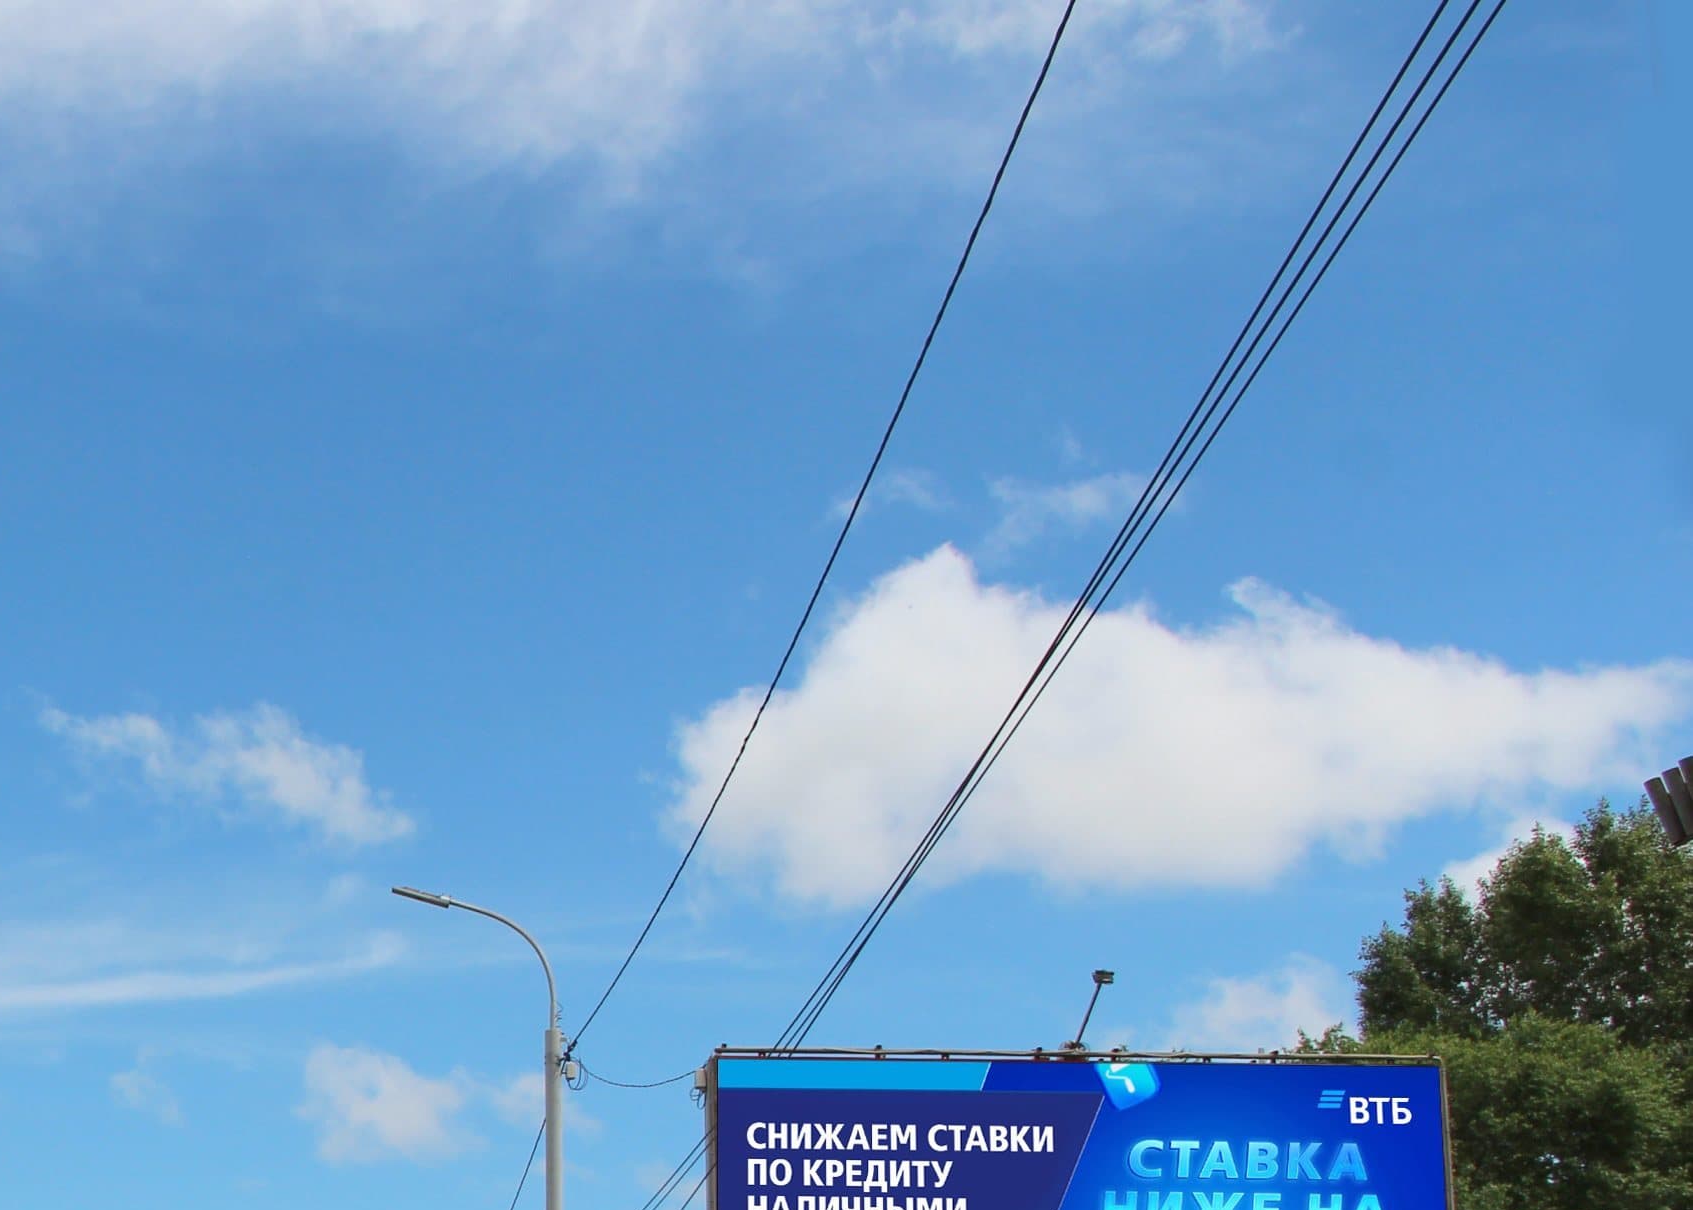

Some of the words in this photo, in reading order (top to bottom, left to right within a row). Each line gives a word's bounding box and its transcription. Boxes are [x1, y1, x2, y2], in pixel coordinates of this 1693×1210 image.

[1349, 1097, 1413, 1125] ВТБ
[746, 1122, 918, 1151] СНИЖАЕМ
[927, 1124, 1054, 1153] СТАВКИ
[747, 1158, 792, 1186] ПО
[803, 1160, 953, 1192] КРЕДИТУ
[1127, 1139, 1368, 1181] СТАВКА
